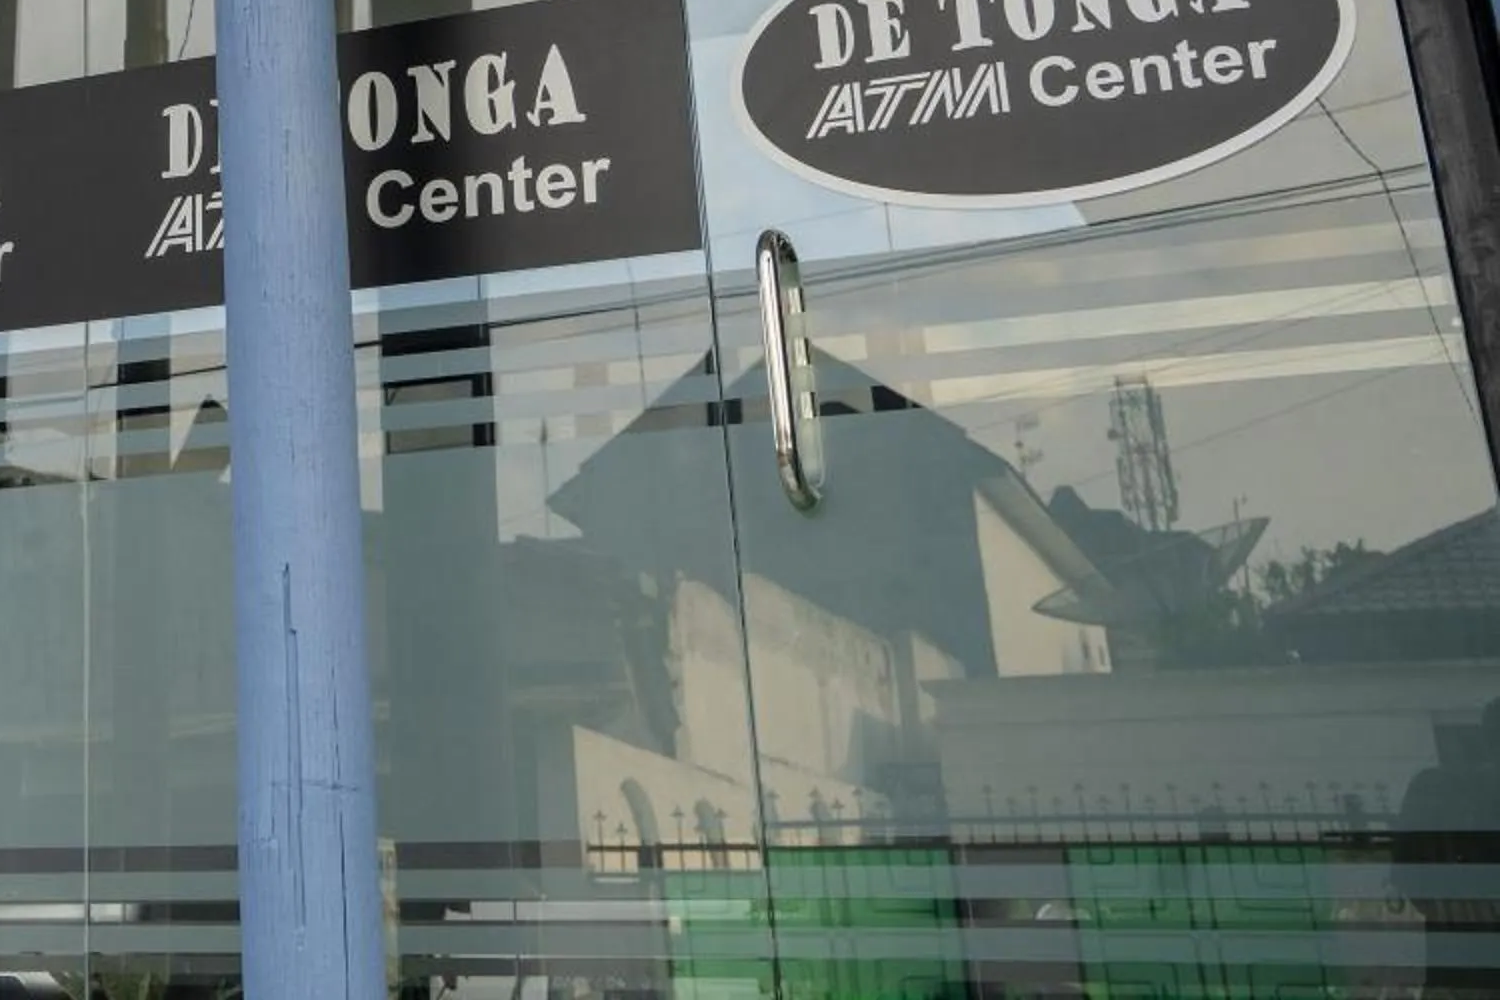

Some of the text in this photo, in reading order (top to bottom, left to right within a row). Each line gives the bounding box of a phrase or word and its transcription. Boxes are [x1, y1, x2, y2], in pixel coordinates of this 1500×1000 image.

[161, 43, 587, 179] D ONGA
[805, 39, 1278, 140] ATM Center
[366, 155, 611, 229] Center
